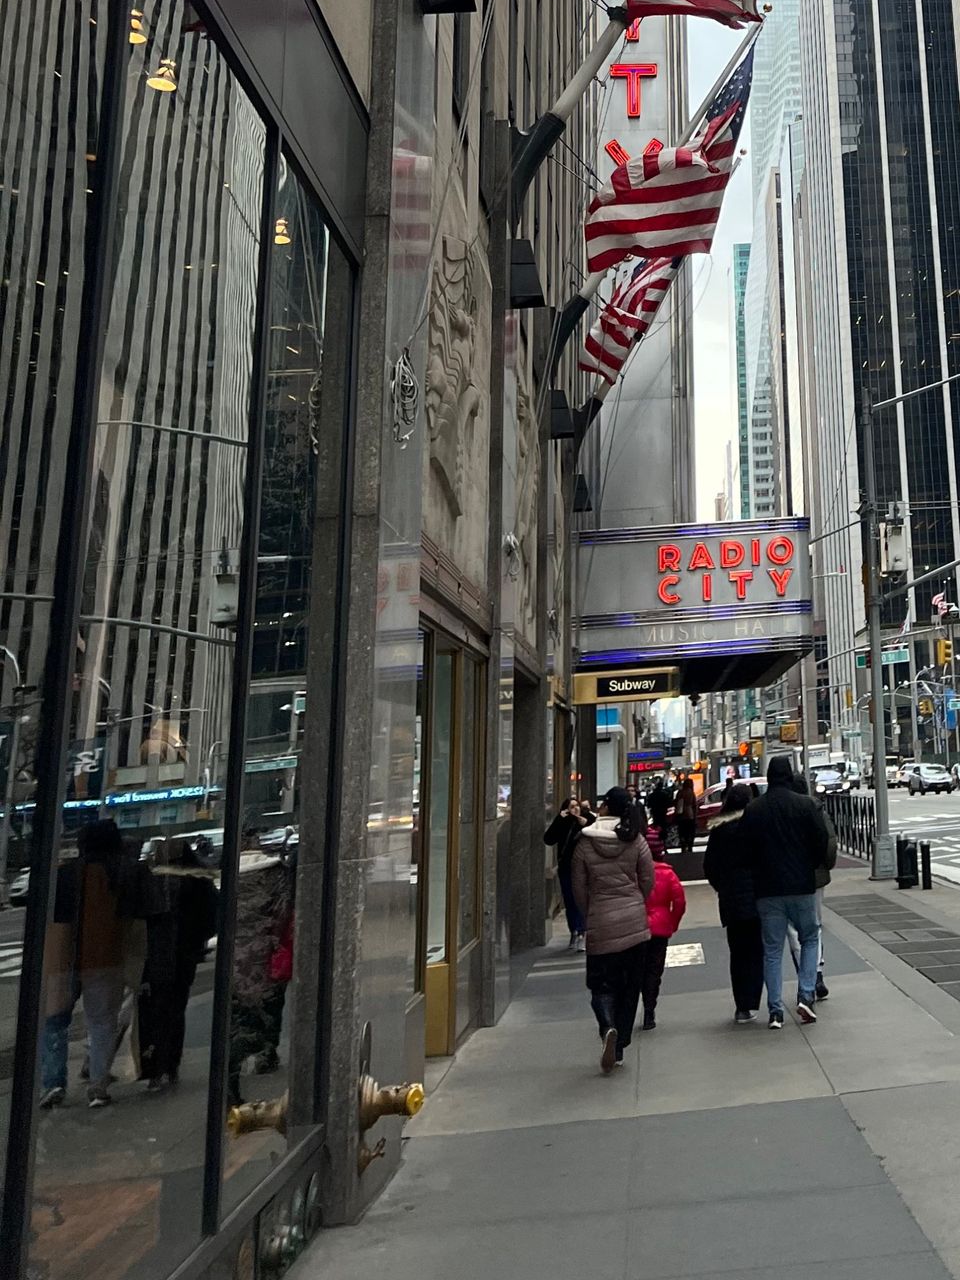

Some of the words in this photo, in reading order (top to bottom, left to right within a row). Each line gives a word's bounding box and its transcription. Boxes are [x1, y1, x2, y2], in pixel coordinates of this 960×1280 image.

[657, 535, 794, 572] RADIO
[658, 568, 793, 604] CITY
[643, 622, 716, 643] MUSIC
[609, 679, 656, 692] Subway
